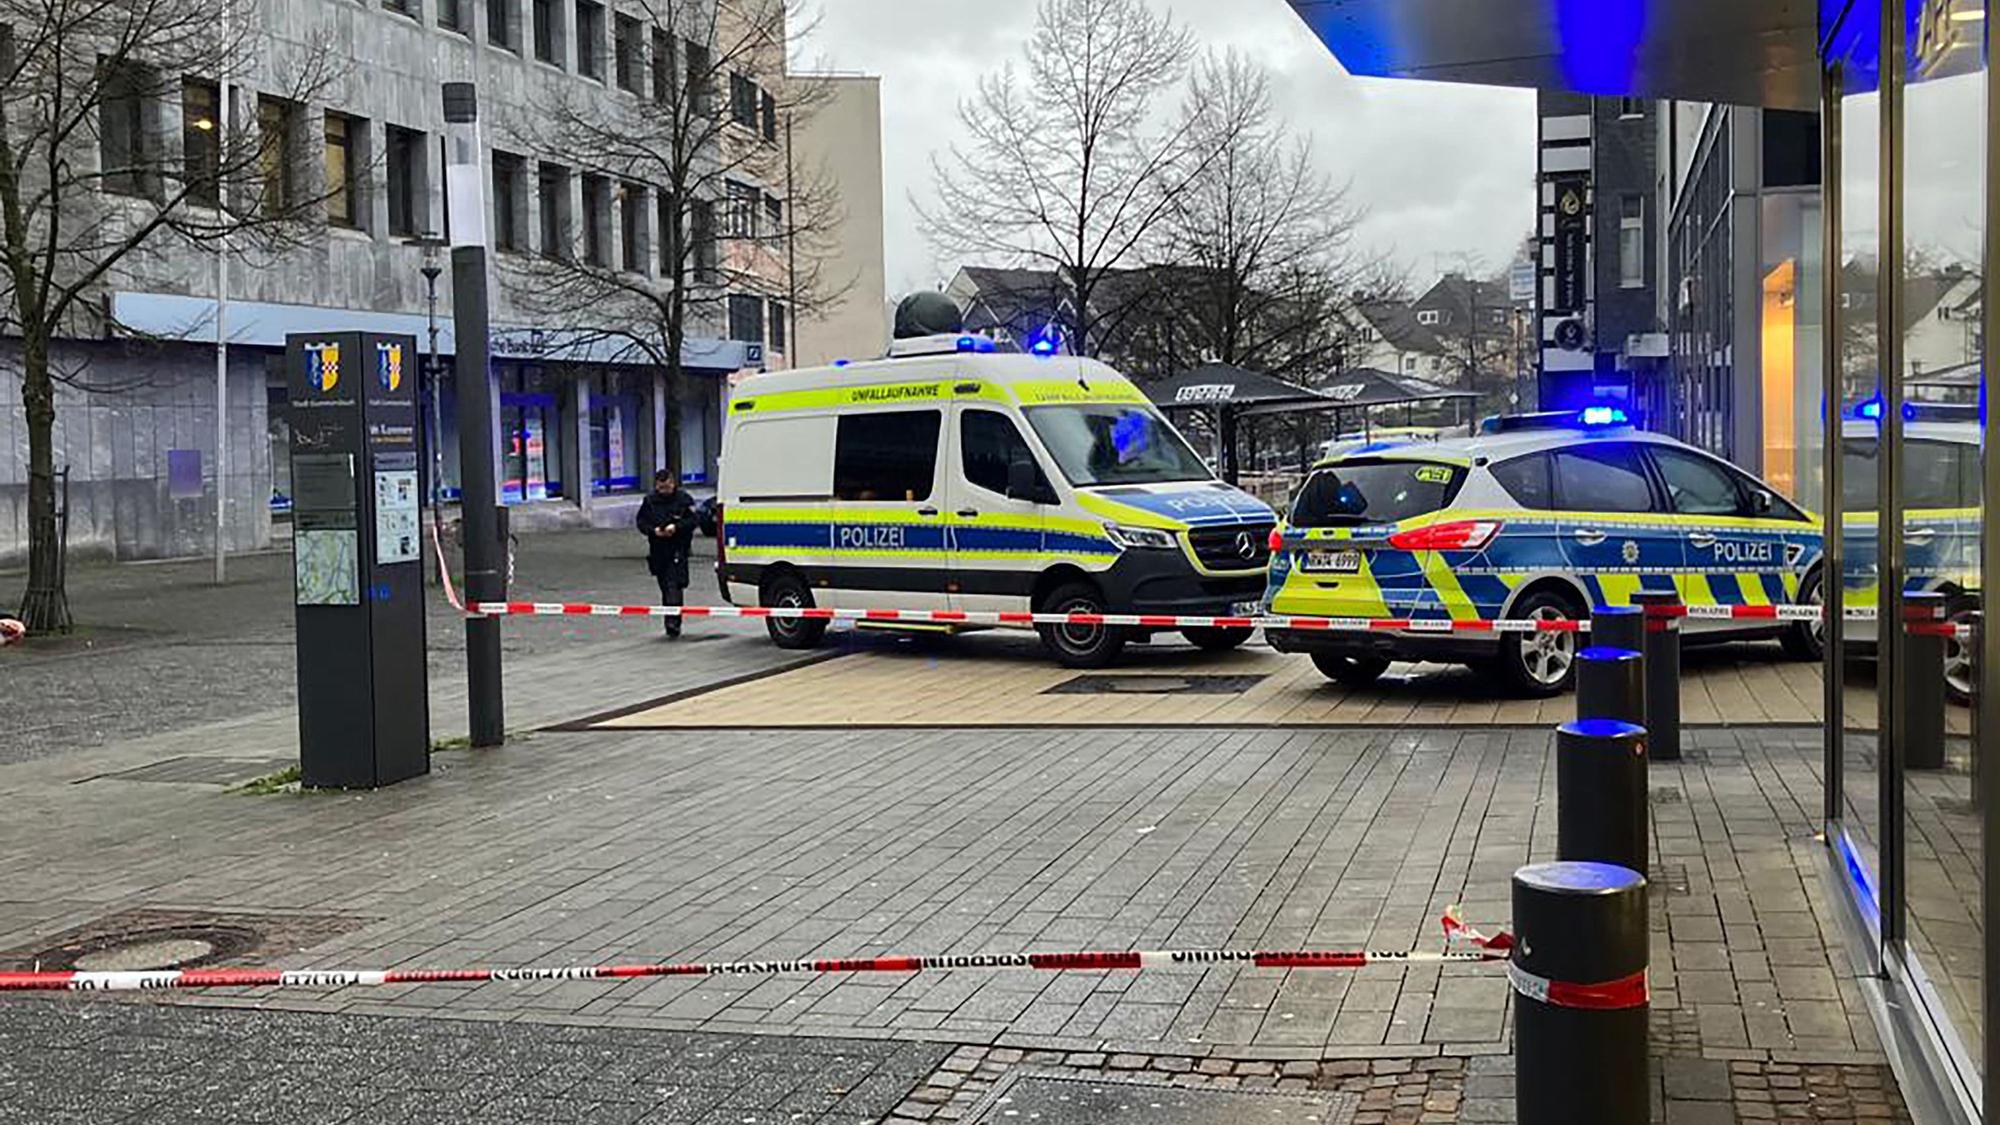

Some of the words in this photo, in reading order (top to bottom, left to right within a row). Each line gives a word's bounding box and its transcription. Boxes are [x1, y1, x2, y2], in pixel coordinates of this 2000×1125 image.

[851, 384, 939, 401] UNFALLAUFNAHME
[841, 527, 904, 547] POLIZEI
[1714, 543, 1772, 561] POLIZEI
